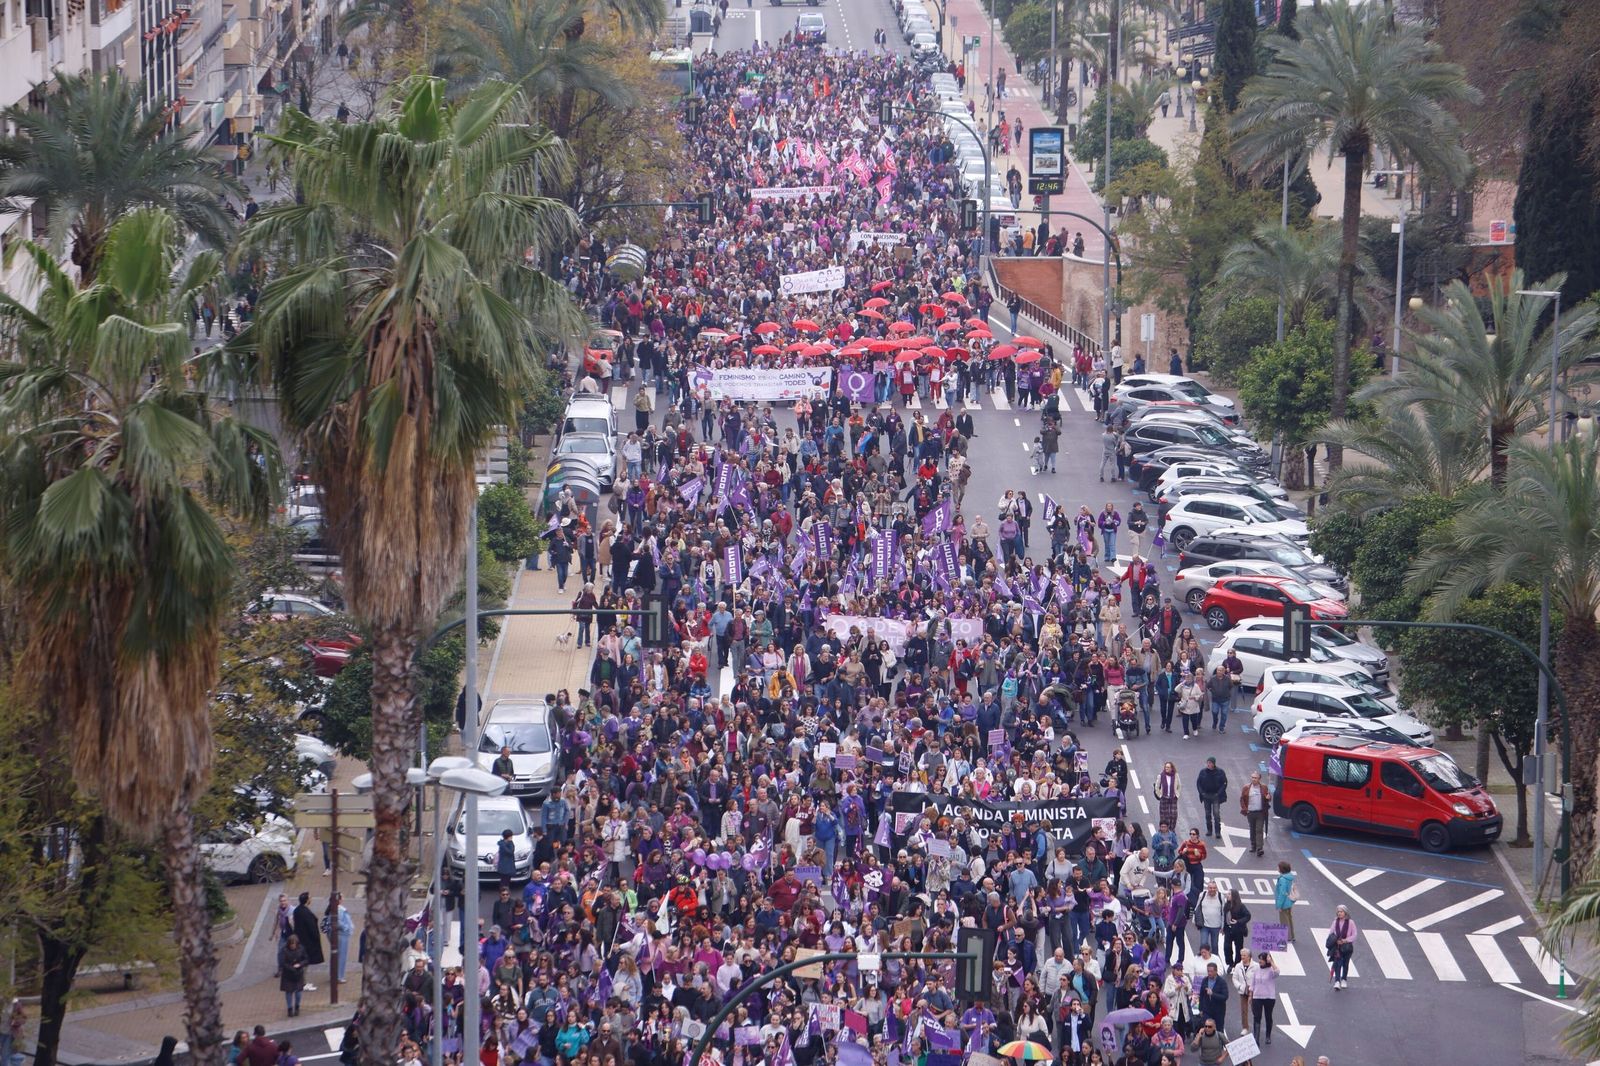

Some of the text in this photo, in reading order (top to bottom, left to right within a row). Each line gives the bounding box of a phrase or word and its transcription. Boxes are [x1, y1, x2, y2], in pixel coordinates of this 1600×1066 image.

[728, 547, 736, 574] CCOO
[943, 804, 1005, 822] AGNDA
[1008, 806, 1087, 822] FMINISTA
